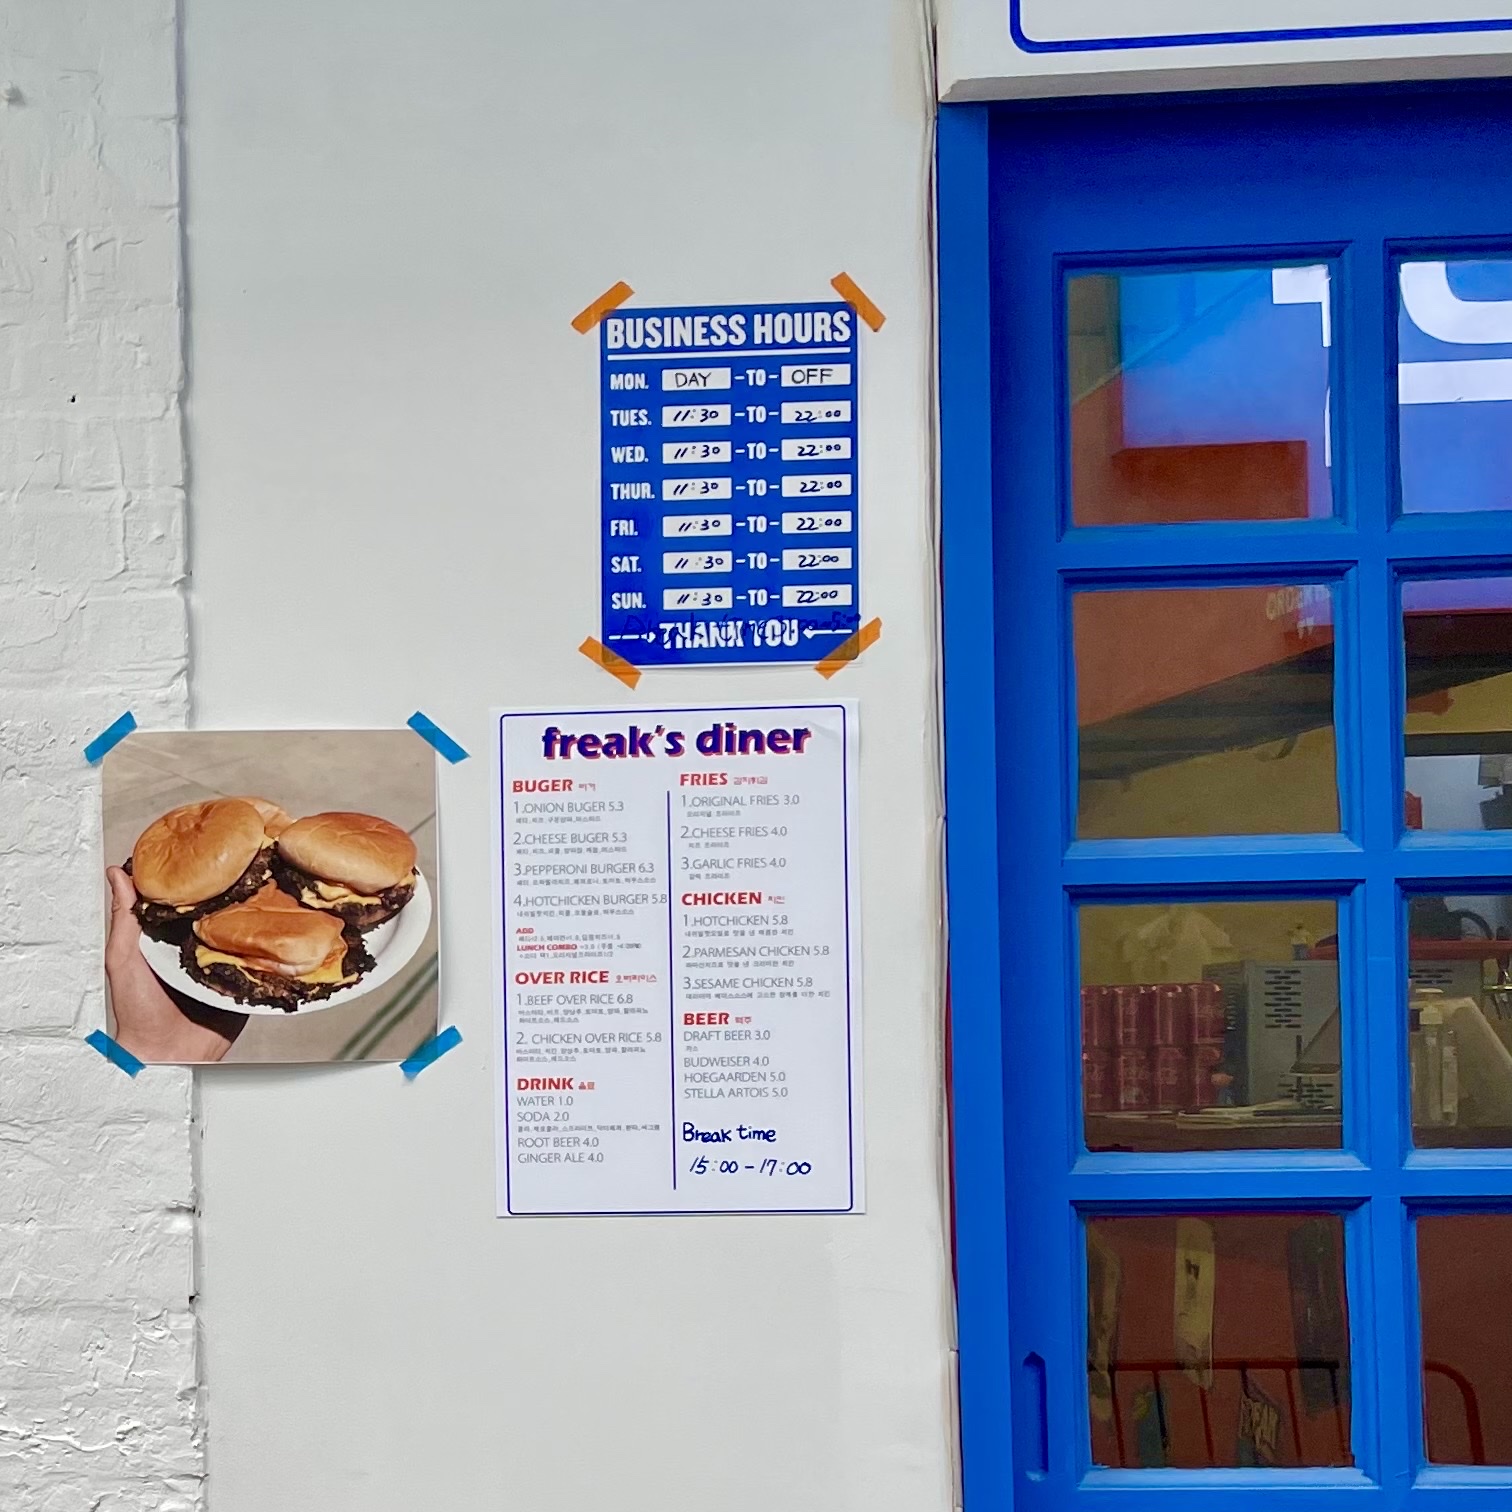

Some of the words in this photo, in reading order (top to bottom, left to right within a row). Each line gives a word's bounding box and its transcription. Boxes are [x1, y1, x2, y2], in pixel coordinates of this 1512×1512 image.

[607, 312, 746, 349] BUSINESS
[753, 310, 851, 344] HOURS
[610, 373, 649, 390] MON.
[674, 372, 712, 387] DAY
[791, 368, 833, 384] OFF
[610, 409, 652, 426] TUES.
[610, 447, 648, 463] WED.
[610, 483, 655, 500] THUR.
[610, 520, 638, 536] FRI.
[611, 556, 642, 573] SAT.
[612, 593, 647, 609] SUN.
[659, 620, 744, 649] THANK
[749, 619, 799, 647] YOU
[542, 725, 685, 760] freak's
[696, 723, 811, 756] diner
[513, 779, 573, 792] BUGER
[680, 773, 728, 786] FRIES
[750, 795, 779, 805] FRIES
[784, 795, 799, 805] 3.0
[567, 802, 606, 812] BUGER
[608, 801, 624, 811] 5.3
[570, 832, 609, 843] BUGER
[612, 832, 627, 842] 5.3
[739, 826, 768, 837] FRIES
[771, 826, 787, 837] 4.0
[591, 863, 636, 874] BURGER
[638, 863, 654, 873] 6.3
[738, 858, 767, 868] FRIES
[770, 858, 786, 868] 4.0
[603, 894, 648, 905] BURGER
[652, 894, 667, 903] 5.8
[681, 892, 762, 905] CHICKEN
[772, 915, 788, 925] 5.8
[759, 945, 810, 956] CHICKEN
[813, 945, 829, 956] 5.8
[515, 972, 565, 985] OVER
[570, 971, 609, 983] RICE
[742, 977, 794, 988] CHICKEN
[797, 977, 813, 987] 5.8
[556, 994, 586, 1005] OVER
[590, 994, 614, 1004] RICE
[617, 994, 633, 1004] 6.8
[683, 1012, 729, 1025] BEER
[516, 1032, 527, 1045] 2.
[531, 1033, 582, 1044] CHICKEN
[585, 1032, 615, 1043] OVER
[618, 1032, 643, 1042] RICE
[646, 1032, 662, 1042] 5.8
[684, 1031, 721, 1041] DRAFT
[724, 1031, 751, 1040] BEER
[755, 1030, 770, 1040] 3.0
[684, 1056, 750, 1067] BUDWEISER
[753, 1056, 769, 1067] 4.0
[684, 1072, 767, 1083] HOEGAARDEN
[770, 1072, 785, 1082] 5.0
[517, 1078, 574, 1090] DRINK
[684, 1088, 724, 1099] STELLA
[728, 1087, 769, 1098] ARTOIS
[772, 1087, 788, 1097] 5.0
[517, 1096, 554, 1106] WATER
[559, 1096, 573, 1105] 1.0
[517, 1112, 550, 1122] SODA
[554, 1112, 569, 1121] 2.0
[683, 1122, 731, 1143] Break
[736, 1125, 776, 1142] time
[518, 1138, 550, 1147] ROOT
[553, 1137, 580, 1147] BEER
[583, 1137, 599, 1147] 4.0
[518, 1153, 561, 1163] GINGER
[564, 1152, 584, 1162] ALE
[588, 1152, 604, 1162] 4.0
